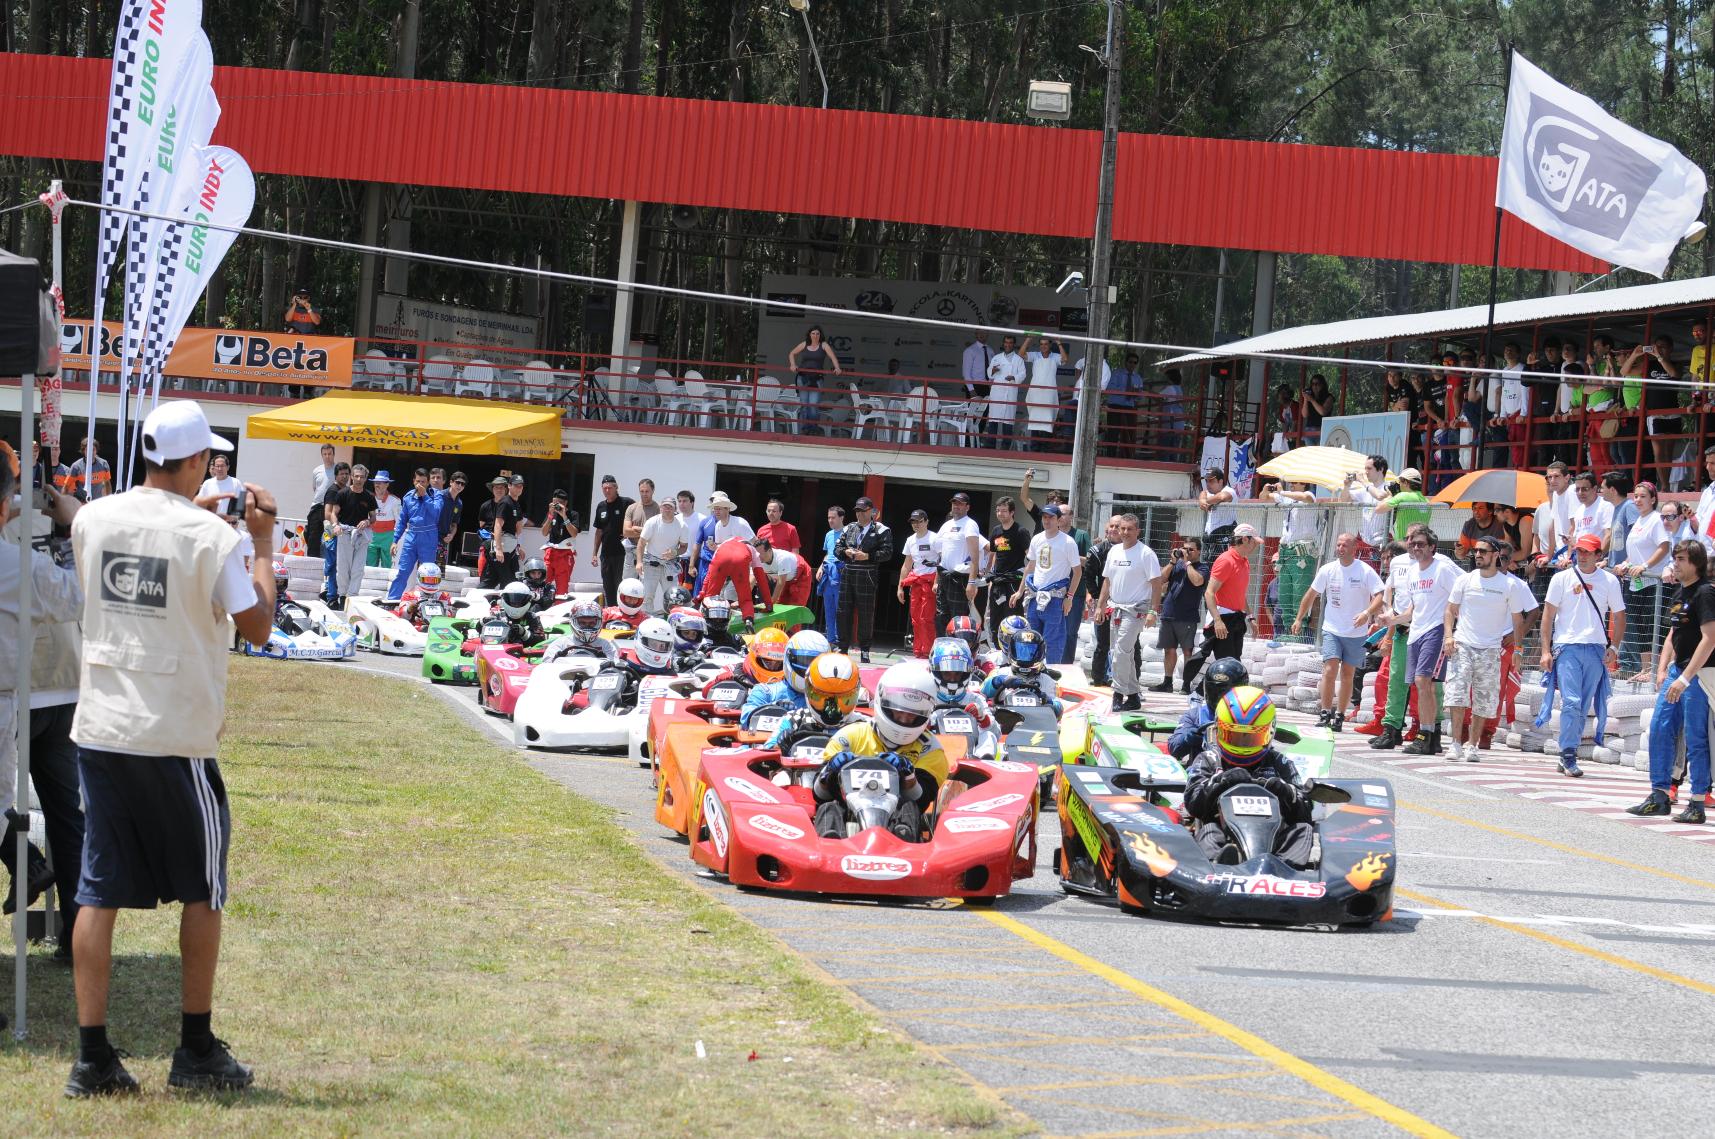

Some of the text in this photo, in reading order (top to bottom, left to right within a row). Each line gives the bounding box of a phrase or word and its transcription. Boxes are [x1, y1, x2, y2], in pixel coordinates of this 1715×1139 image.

[138, 39, 160, 127] EURO
[185, 158, 224, 275] EURO INDY
[413, 308, 434, 319] FUROS
[435, 312, 440, 320] E
[440, 314, 478, 327] SONDAGENS
[479, 319, 487, 328] DE
[246, 336, 329, 372] Beta
[288, 432, 463, 453] www.pestronix.pt
[103, 556, 165, 600] GATA
[857, 770, 883, 779] 74
